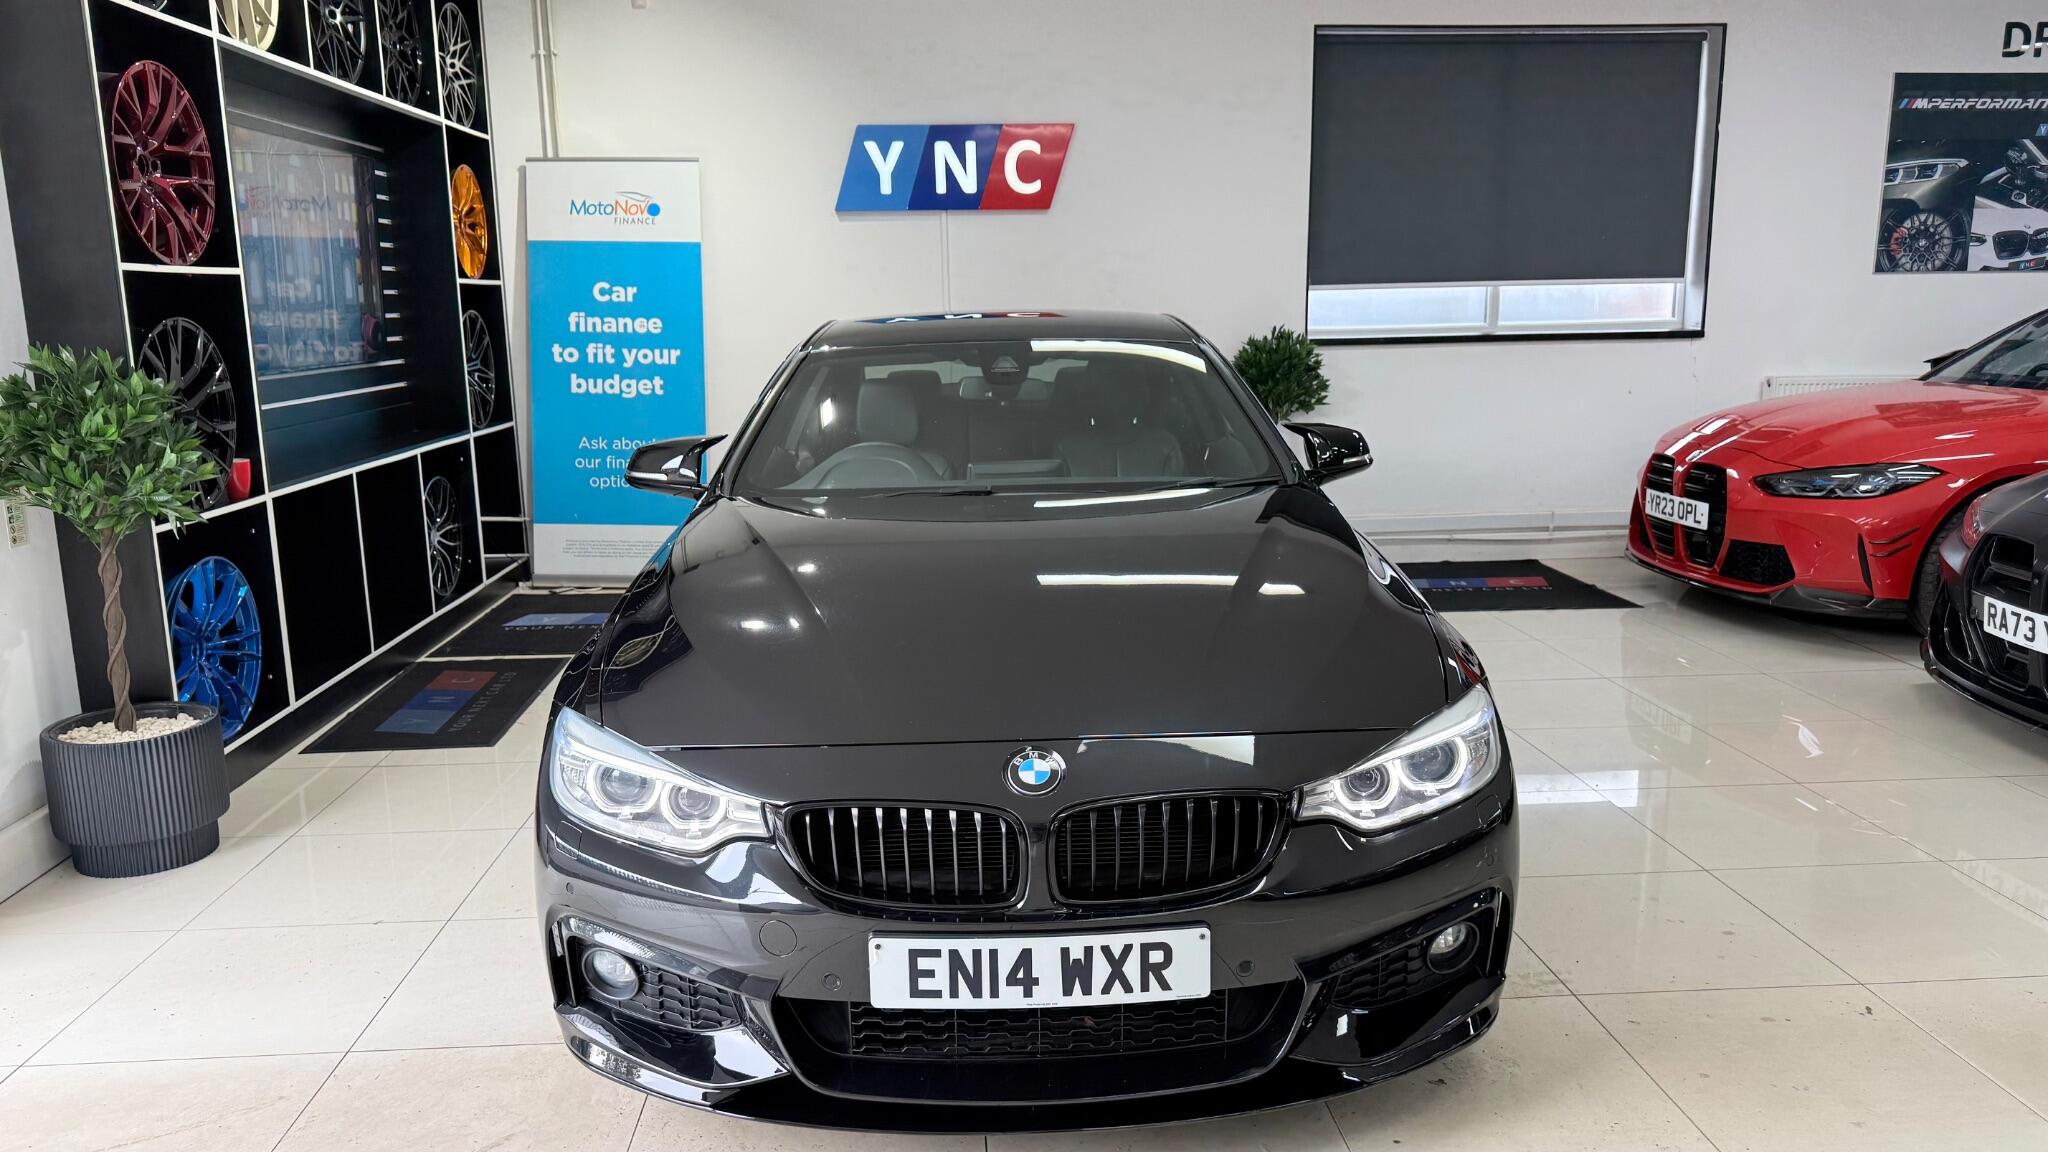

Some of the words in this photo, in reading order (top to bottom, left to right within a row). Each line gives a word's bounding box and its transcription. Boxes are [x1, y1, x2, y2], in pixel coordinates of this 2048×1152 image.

[863, 139, 1042, 195] YNC
[613, 217, 656, 225] FINANCE
[592, 281, 638, 302] Car
[568, 312, 663, 333] finance
[552, 343, 579, 364] to
[586, 343, 615, 364] fit
[622, 348, 681, 368] your
[570, 373, 665, 398] budget
[578, 436, 608, 450] Ask
[612, 436, 656, 450] abo
[575, 457, 602, 469] our
[1650, 492, 1675, 517] YR23
[1677, 500, 1701, 524] OPL
[1987, 602, 2036, 643] RA73
[1013, 752, 1055, 766] BMW
[907, 947, 1040, 1000] EN14
[1059, 941, 1174, 997] WXR
